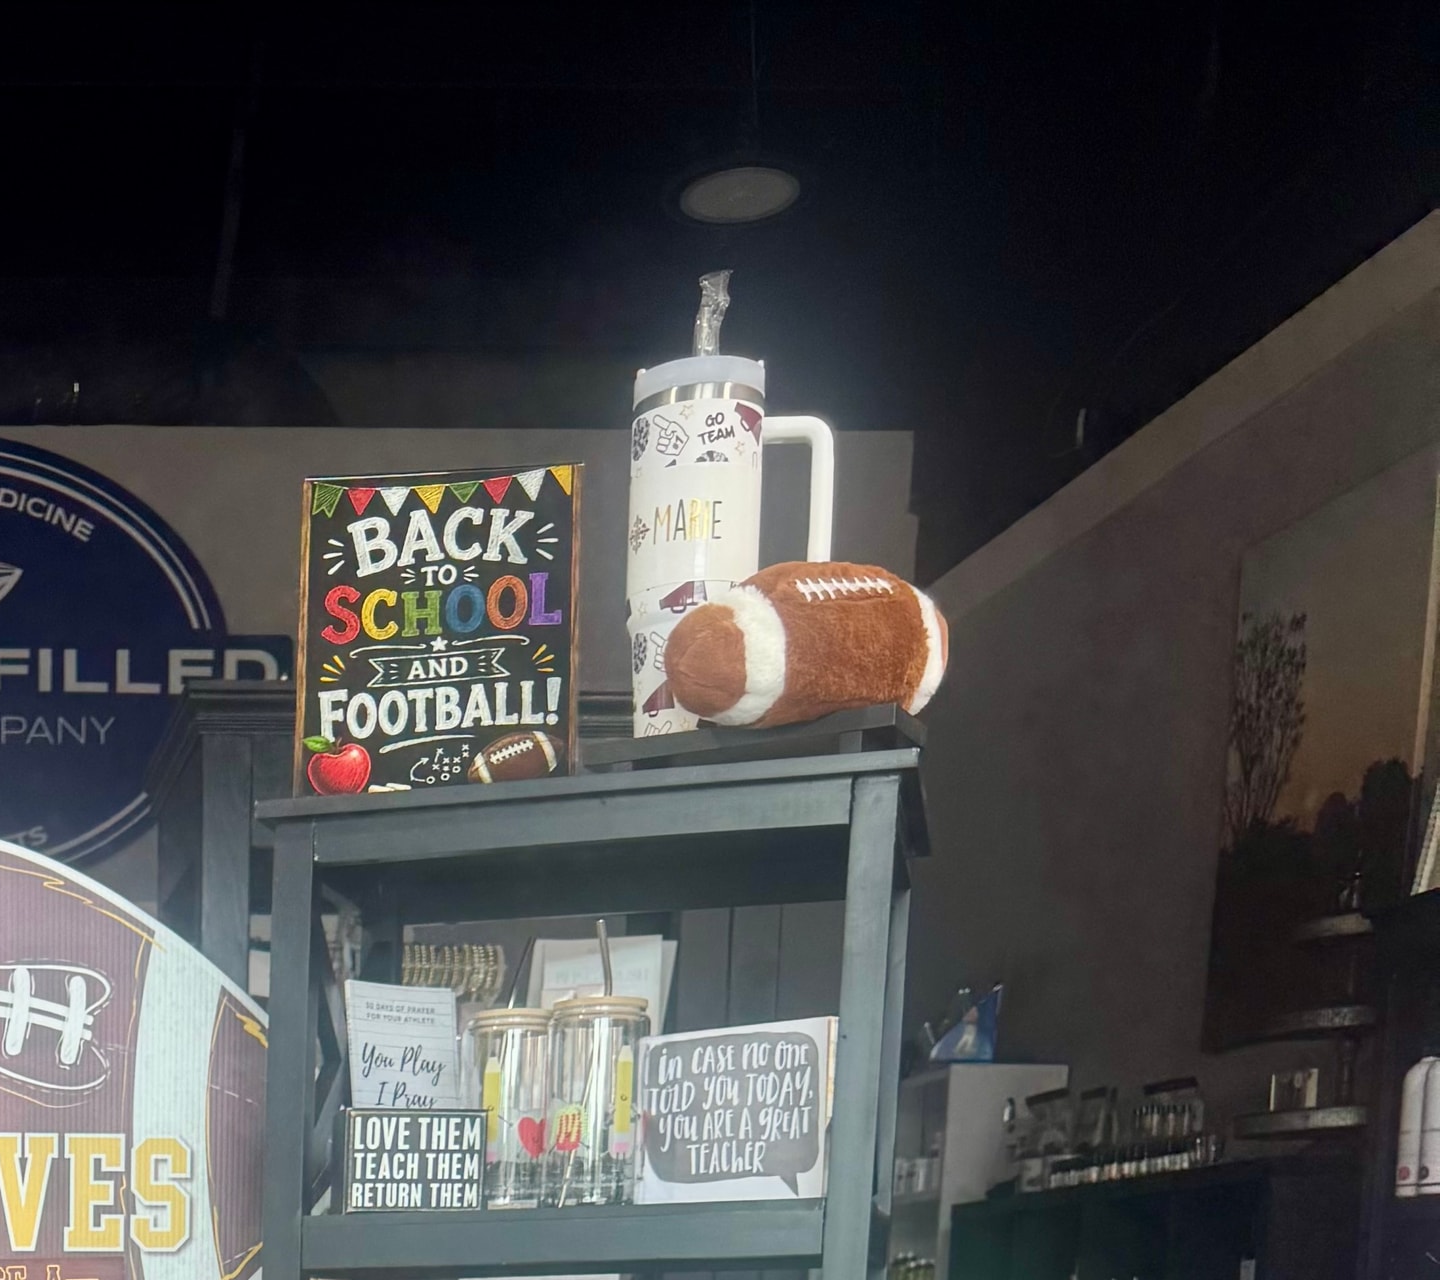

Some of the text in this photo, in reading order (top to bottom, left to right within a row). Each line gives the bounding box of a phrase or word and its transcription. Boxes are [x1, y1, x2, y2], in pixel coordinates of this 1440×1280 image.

[697, 425, 736, 445] TEAM
[705, 412, 725, 427] GO
[345, 505, 536, 579] BACK
[421, 564, 458, 587] TO
[320, 571, 563, 645] SCHOOL
[405, 655, 469, 681] AND
[317, 675, 563, 741] FOOTBALL!
[361, 1042, 447, 1087] You Play
[658, 1048, 682, 1085] in
[692, 1045, 735, 1074] CASE
[392, 1081, 437, 1109] Pray
[649, 1066, 814, 1116] TOLD you TODAY,
[353, 1116, 480, 1151] LOVE THEM
[659, 1114, 698, 1152] you
[702, 1108, 735, 1141] ARE
[739, 1107, 753, 1140] A
[353, 1151, 479, 1181] TEACH THEM
[351, 1181, 479, 1209] RETURN THEM
